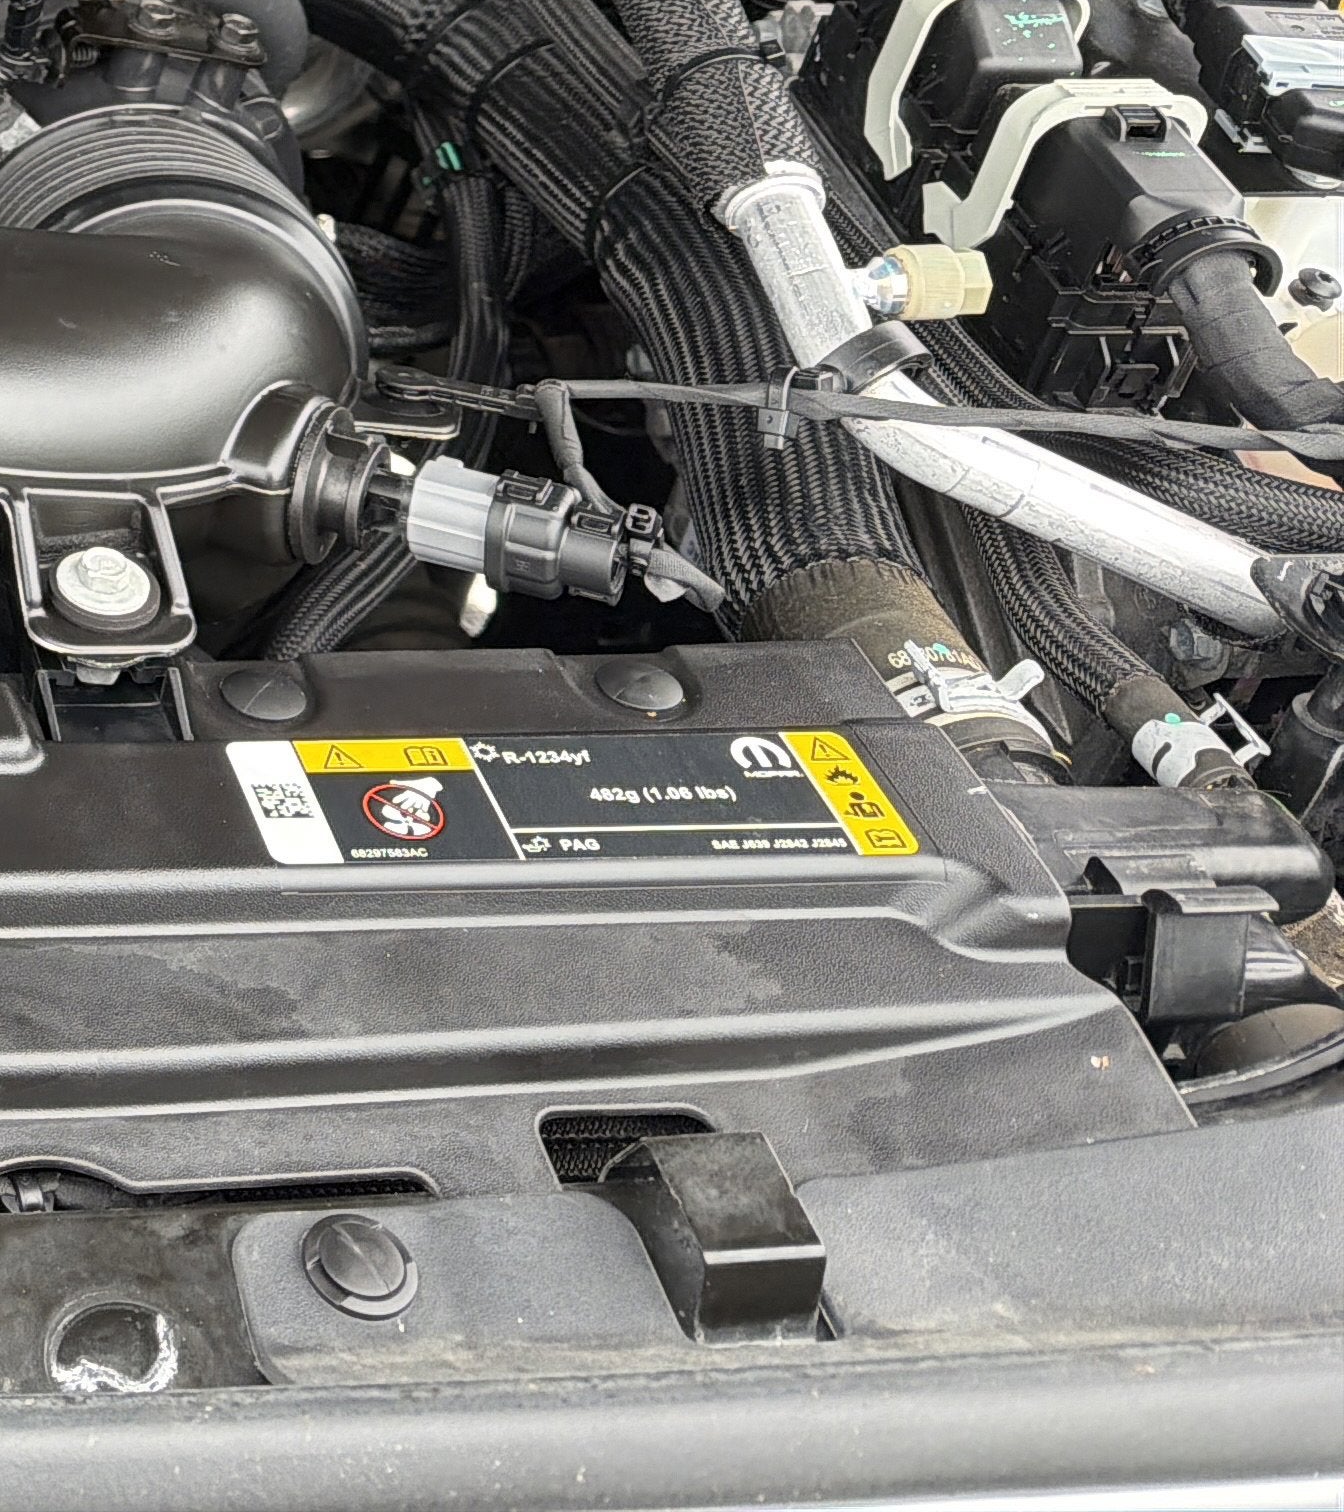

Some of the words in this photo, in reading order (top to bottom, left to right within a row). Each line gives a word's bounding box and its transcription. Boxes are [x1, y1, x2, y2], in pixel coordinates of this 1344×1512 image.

[502, 749, 591, 765] R-1234yf
[590, 787, 641, 804] 482g
[642, 786, 693, 804] (1.06
[694, 784, 738, 803] lbs)
[558, 838, 601, 852] PAG
